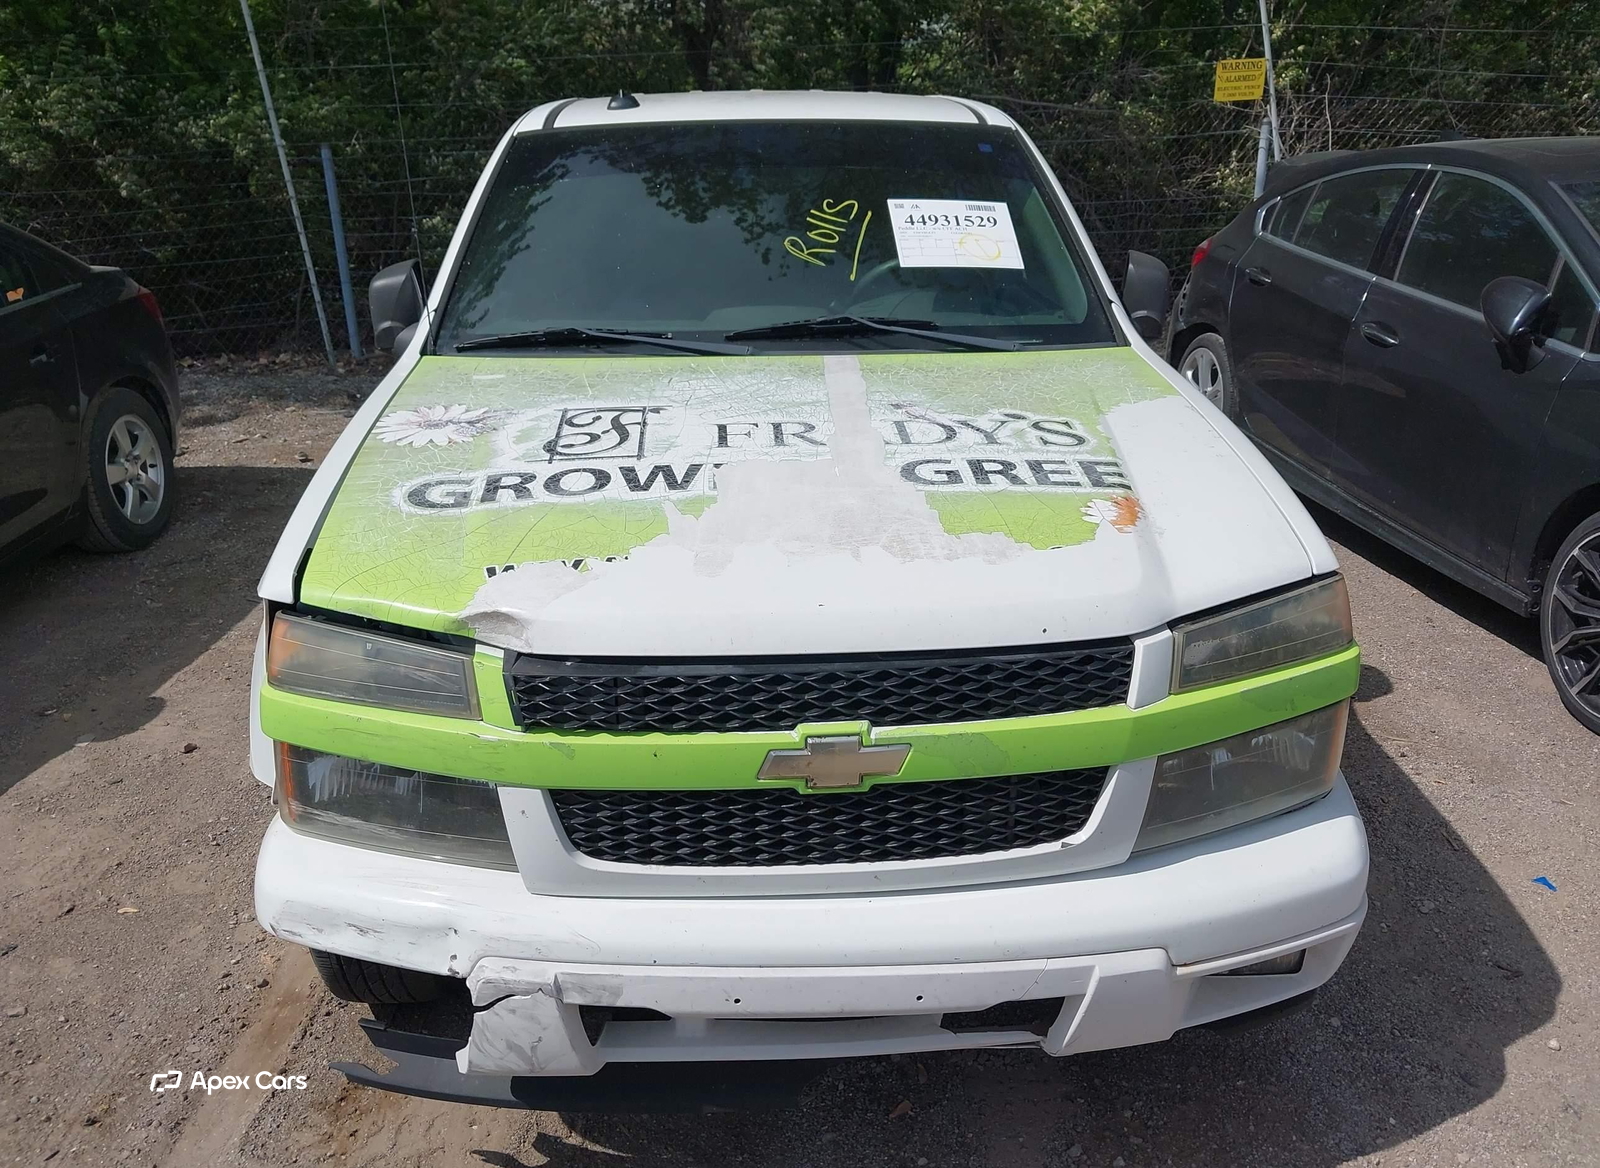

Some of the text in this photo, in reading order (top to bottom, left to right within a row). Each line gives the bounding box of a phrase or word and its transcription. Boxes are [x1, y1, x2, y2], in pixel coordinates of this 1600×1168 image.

[1221, 61, 1262, 70] WARNING
[1225, 74, 1256, 83] ALARMED
[904, 213, 998, 229] 44931529
